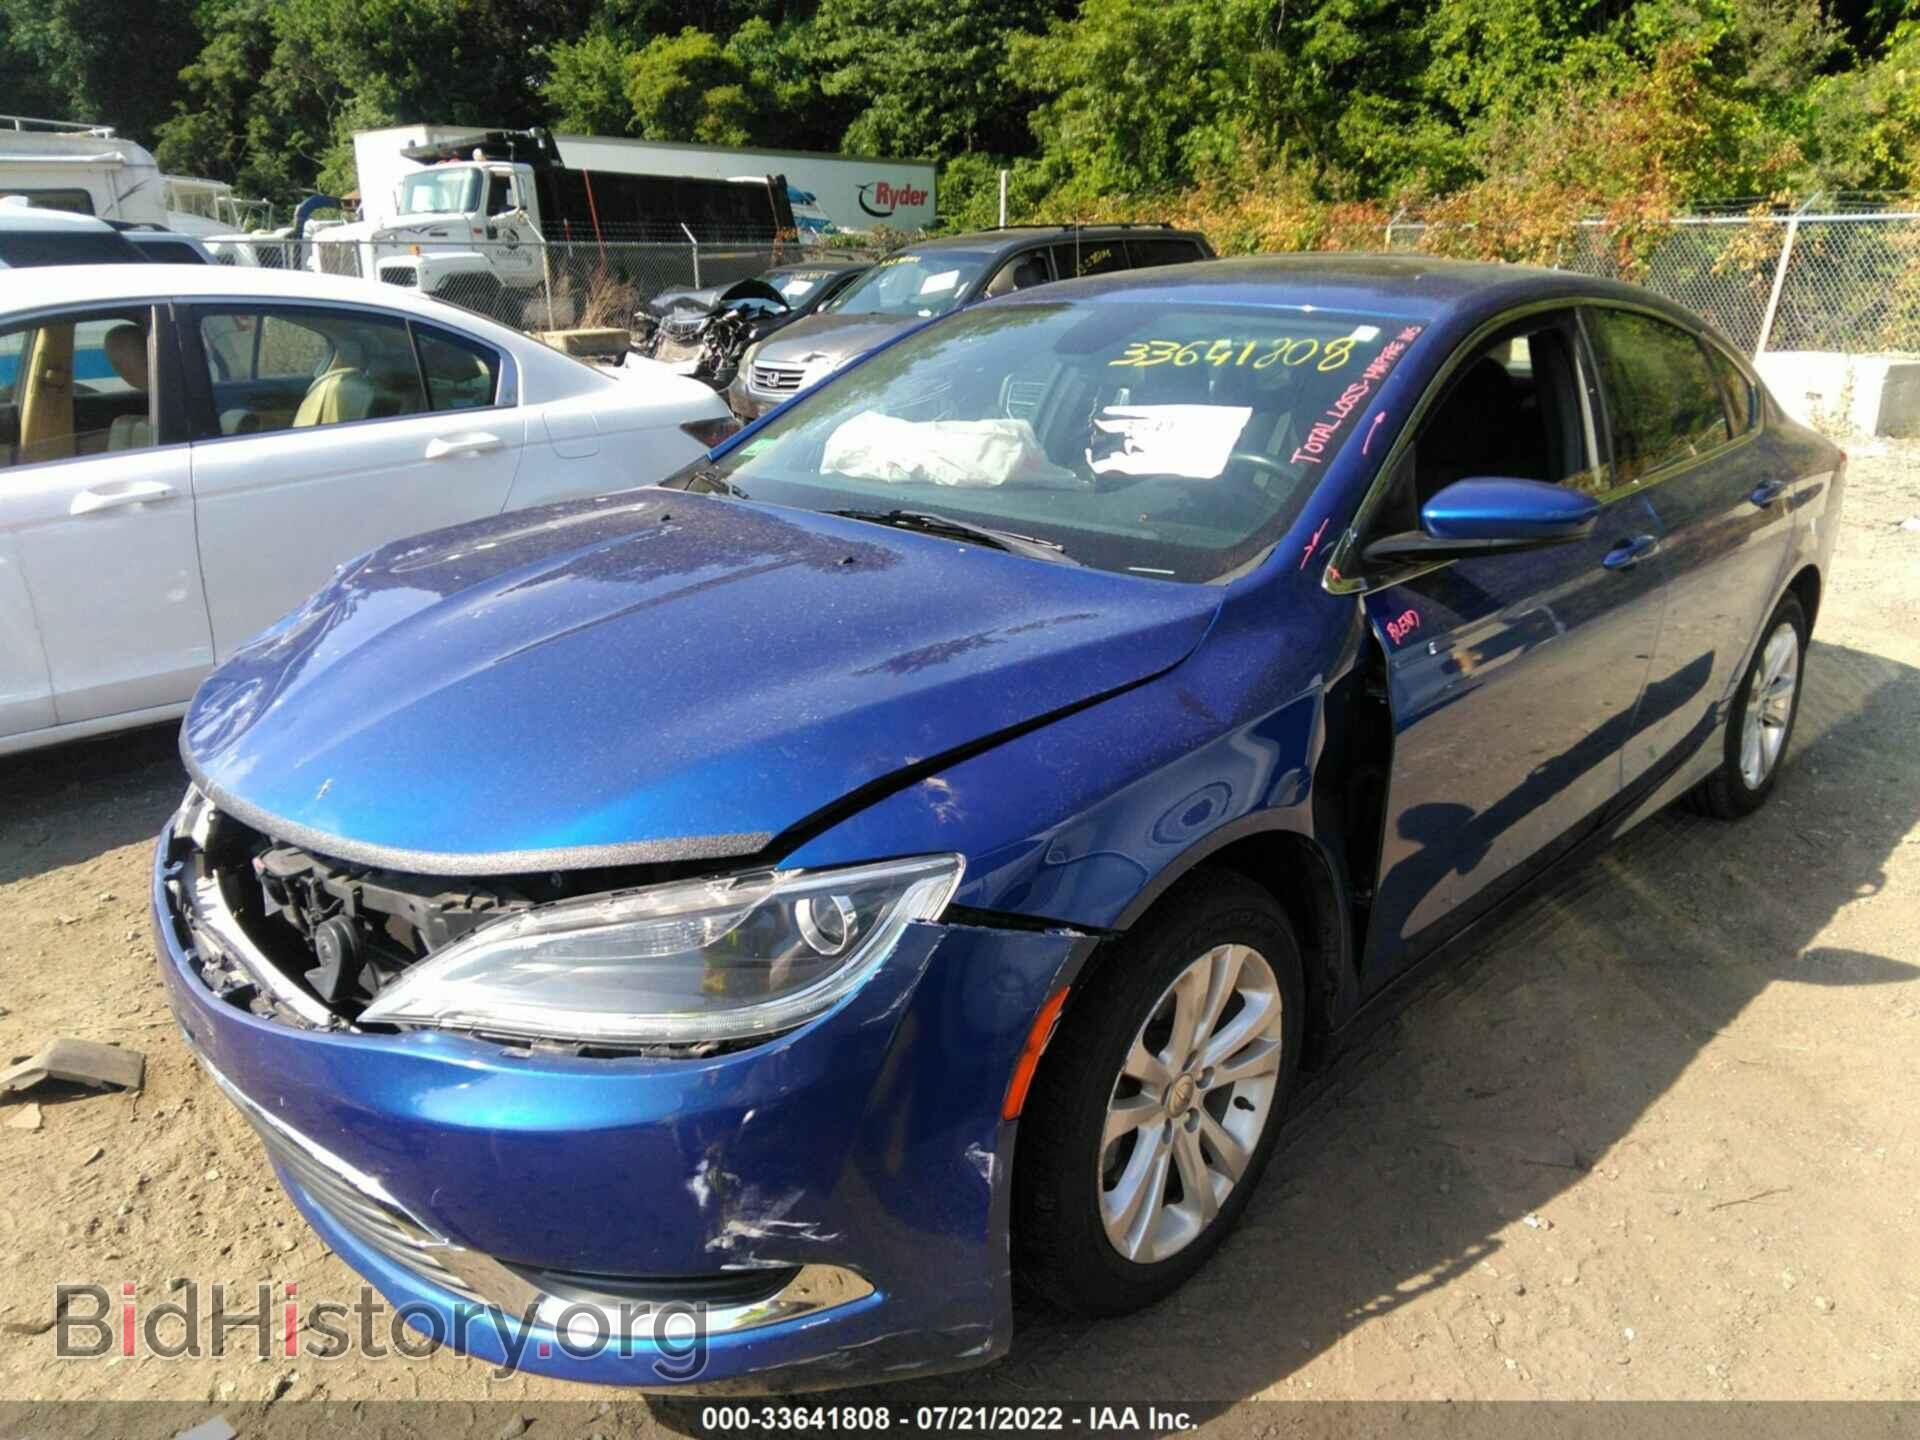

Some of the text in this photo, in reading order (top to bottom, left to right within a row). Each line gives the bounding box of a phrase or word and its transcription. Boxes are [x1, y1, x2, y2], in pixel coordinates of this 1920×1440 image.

[875, 181, 929, 211] Ryder
[1108, 336, 1356, 372] 33641808
[1290, 419, 1341, 464] TOTAL
